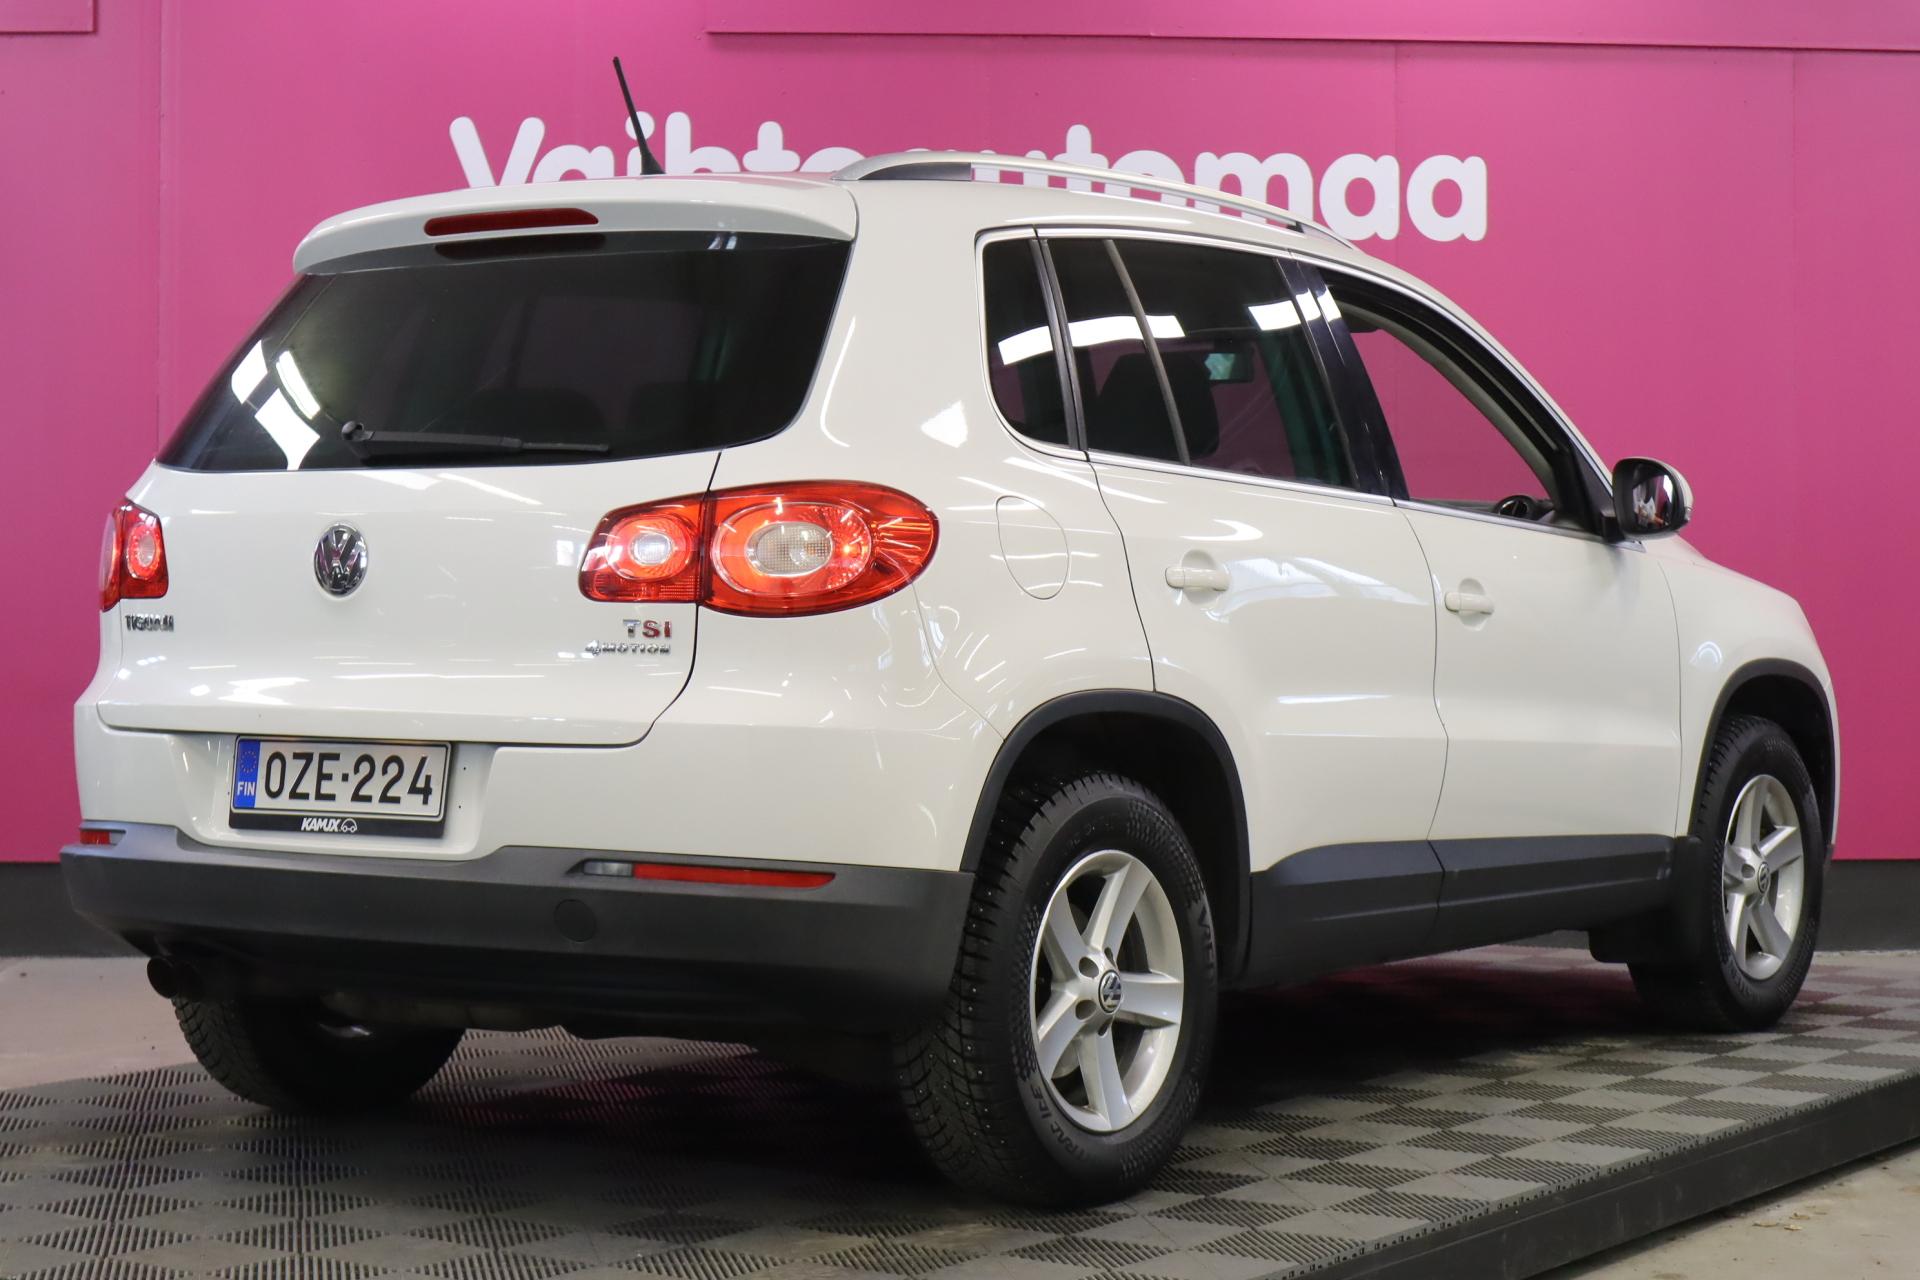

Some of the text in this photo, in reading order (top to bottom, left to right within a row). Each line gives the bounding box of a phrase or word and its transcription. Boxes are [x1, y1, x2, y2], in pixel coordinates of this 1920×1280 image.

[449, 111, 1487, 242] Vihttmaa
[622, 619, 671, 638] TSI
[585, 640, 671, 656] 4MOTION
[264, 751, 433, 805] OZE-224
[237, 781, 255, 796] FIN
[301, 817, 340, 832] KAMUX
